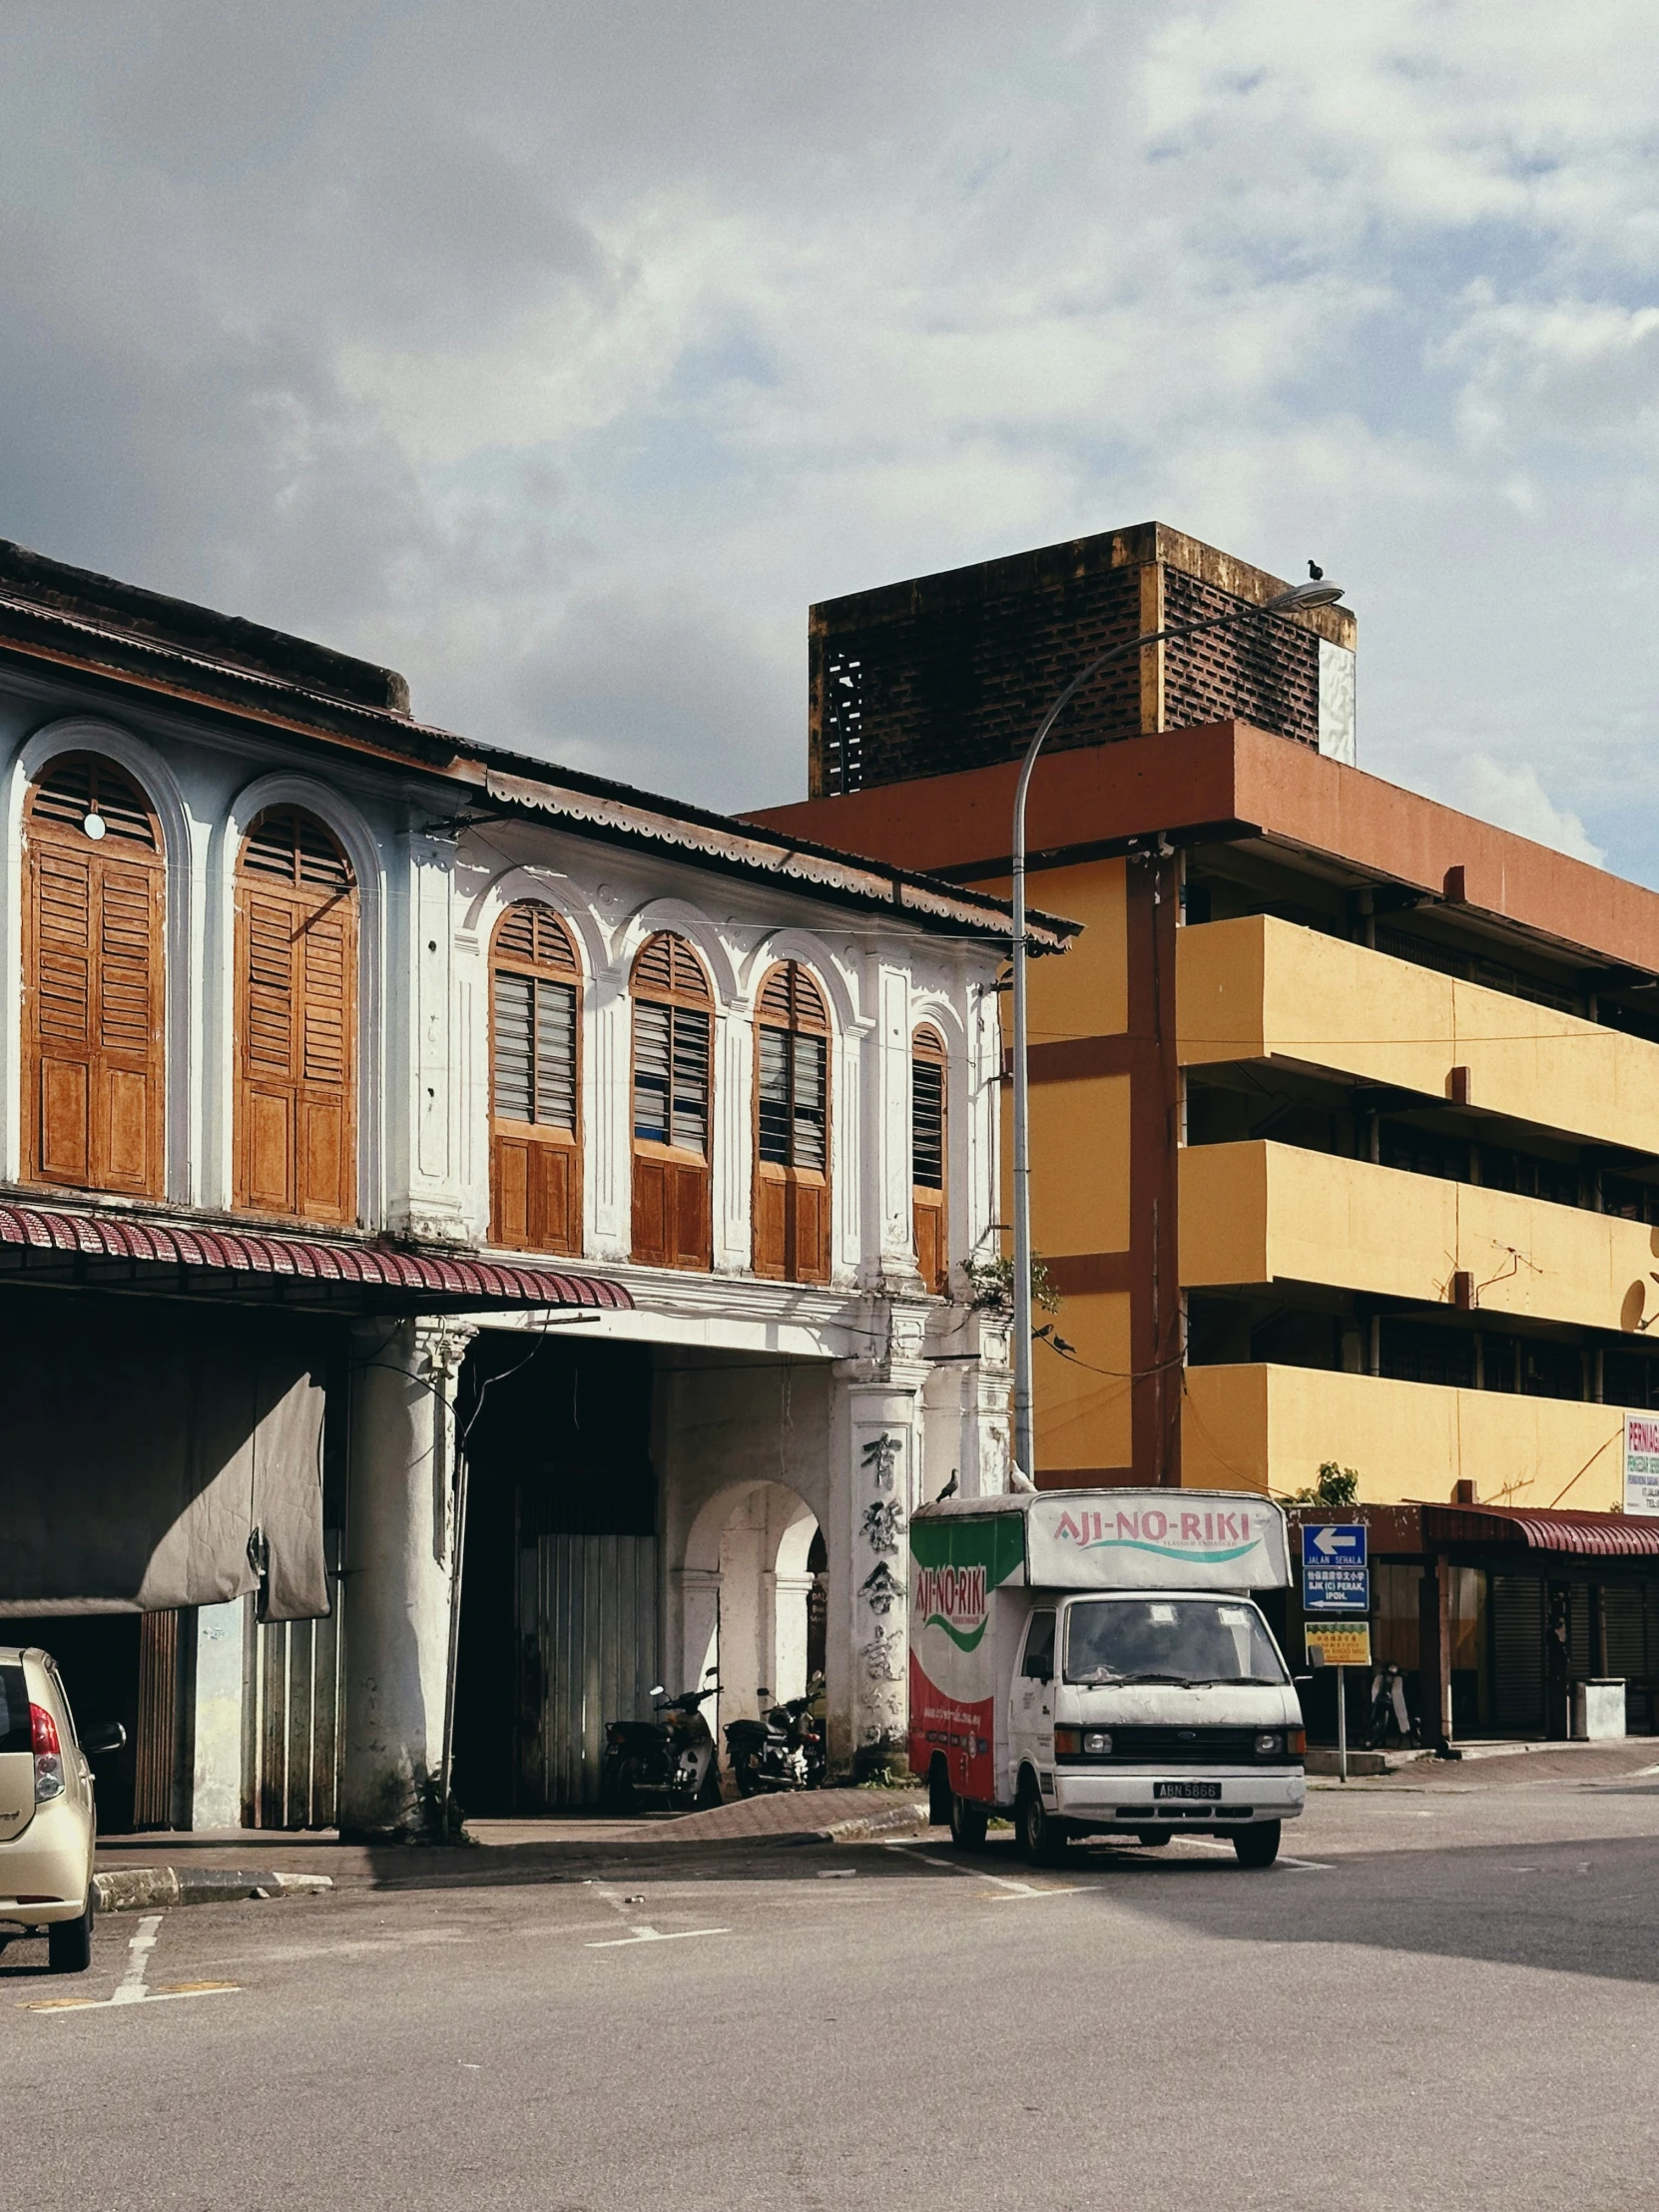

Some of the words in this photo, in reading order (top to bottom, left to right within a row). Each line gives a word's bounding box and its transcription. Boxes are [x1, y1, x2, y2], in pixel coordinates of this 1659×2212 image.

[1053, 1510, 1250, 1546] AJI-NO-RIKI
[1335, 1555, 1362, 1564] SEHALA
[1309, 1581, 1324, 1590] SJK
[1325, 1581, 1336, 1591] (C)
[914, 1567, 985, 1622] AJI-NO-RIKI
[1160, 1784, 1183, 1798] ABN
[1185, 1784, 1216, 1798] 5866
